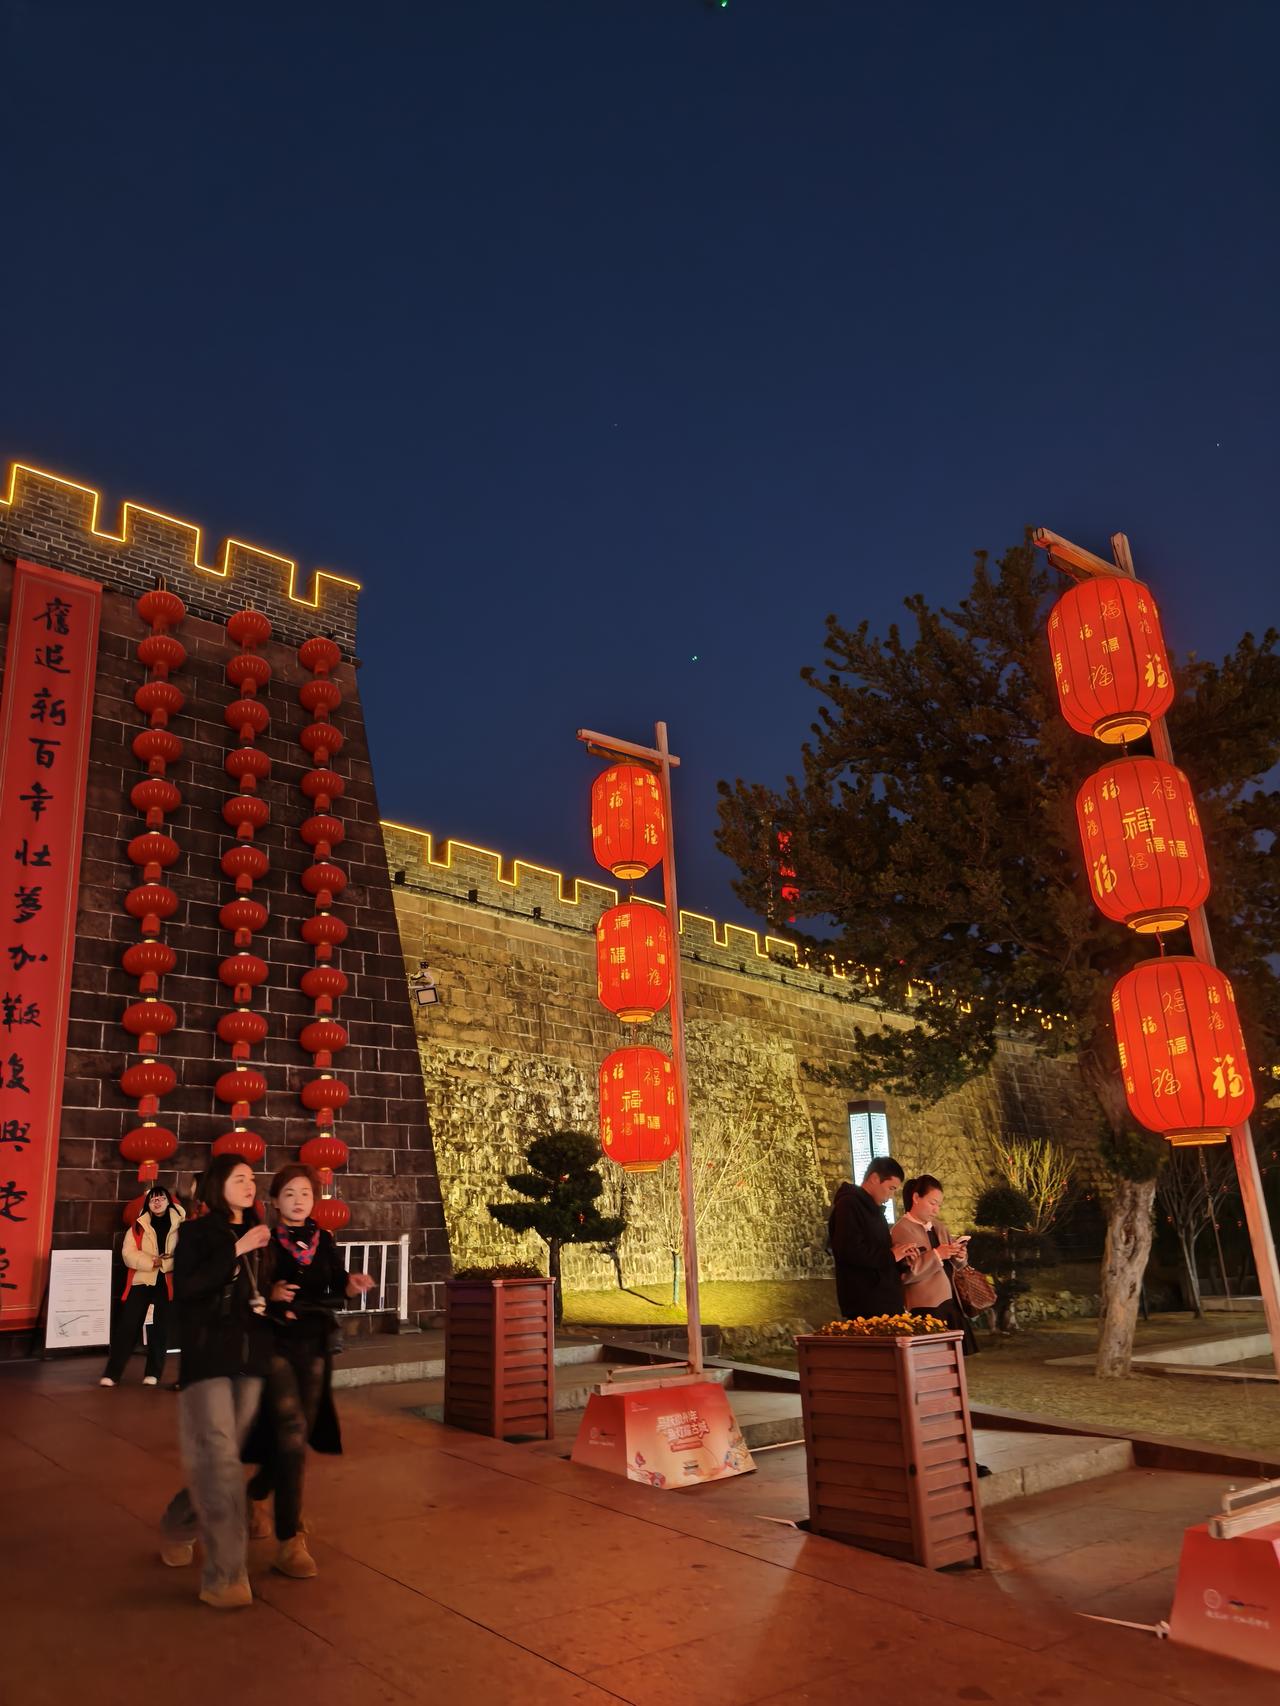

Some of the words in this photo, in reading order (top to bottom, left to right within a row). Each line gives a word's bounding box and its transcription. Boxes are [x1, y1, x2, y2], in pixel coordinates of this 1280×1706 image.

[1100, 600, 1120, 620] 福
[1080, 624, 1093, 640] 福
[1101, 637, 1119, 654] 福
[1088, 664, 1113, 690] 福
[1145, 653, 1168, 688] 福
[1102, 778, 1120, 800] 福
[1152, 777, 1177, 800] 福
[609, 791, 623, 808] 福
[1084, 797, 1095, 815] 福
[1122, 807, 1156, 841] 福
[645, 824, 658, 844] 福
[1146, 837, 1166, 853] 福
[1168, 840, 1188, 857] 福
[1093, 853, 1117, 898] 福
[614, 913, 631, 930] 福
[610, 946, 625, 964] 福
[647, 967, 661, 985] 福
[1162, 988, 1187, 1015] 福
[1208, 986, 1220, 1004] 福
[1142, 1016, 1157, 1035] 福
[1167, 1036, 1188, 1056] 福
[613, 1062, 624, 1079] 福
[644, 1067, 661, 1086] 福
[1213, 1054, 1245, 1099] 福
[1152, 1069, 1181, 1098] 福
[621, 1090, 643, 1112] 福
[633, 1113, 645, 1125] 福
[647, 1115, 660, 1129] 福
[603, 1116, 613, 1145] 福
